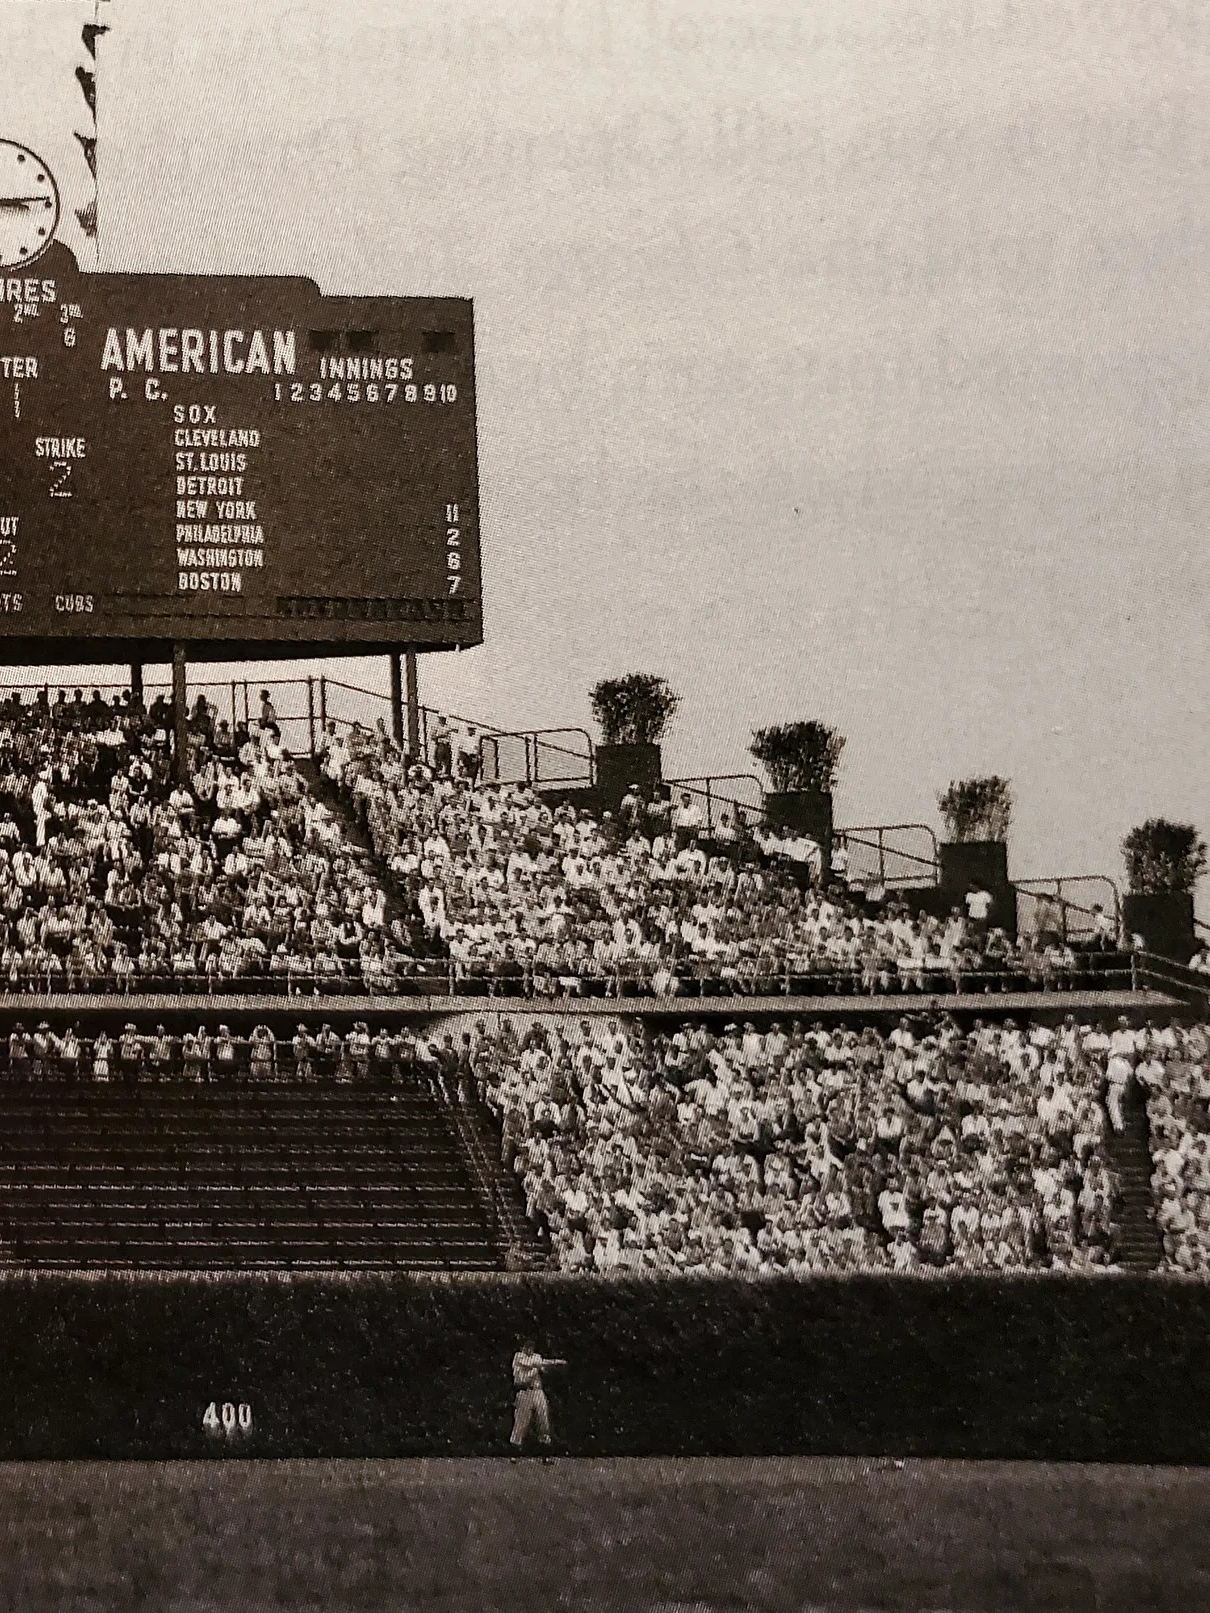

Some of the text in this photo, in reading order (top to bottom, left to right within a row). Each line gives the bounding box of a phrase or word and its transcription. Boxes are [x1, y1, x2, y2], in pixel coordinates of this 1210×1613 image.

[100, 327, 296, 375] AMERICAN
[319, 356, 414, 380] INNINGS
[109, 376, 168, 401] P. C.
[274, 382, 282, 401] 1
[290, 382, 304, 402] 2
[309, 382, 323, 402] 3
[327, 382, 342, 402] 4
[346, 383, 361, 402] 5
[366, 383, 379, 403] 6
[384, 383, 399, 402] 7
[404, 384, 418, 403] 8
[440, 384, 458, 404] 10
[173, 404, 216, 424] SOX
[35, 436, 86, 458] STRIKE
[174, 428, 261, 448] CLEVELAND
[49, 460, 73, 497] 2
[176, 475, 244, 496] DETROIT
[176, 499, 257, 520] NEW YORK
[176, 523, 265, 545] PHILADELPHIA
[446, 528, 461, 546] 2
[176, 547, 264, 568] WASHINGTON
[178, 571, 242, 592] BOSTON
[446, 575, 462, 594] 7
[55, 594, 94, 613] CUBS
[201, 1401, 253, 1434] 400
